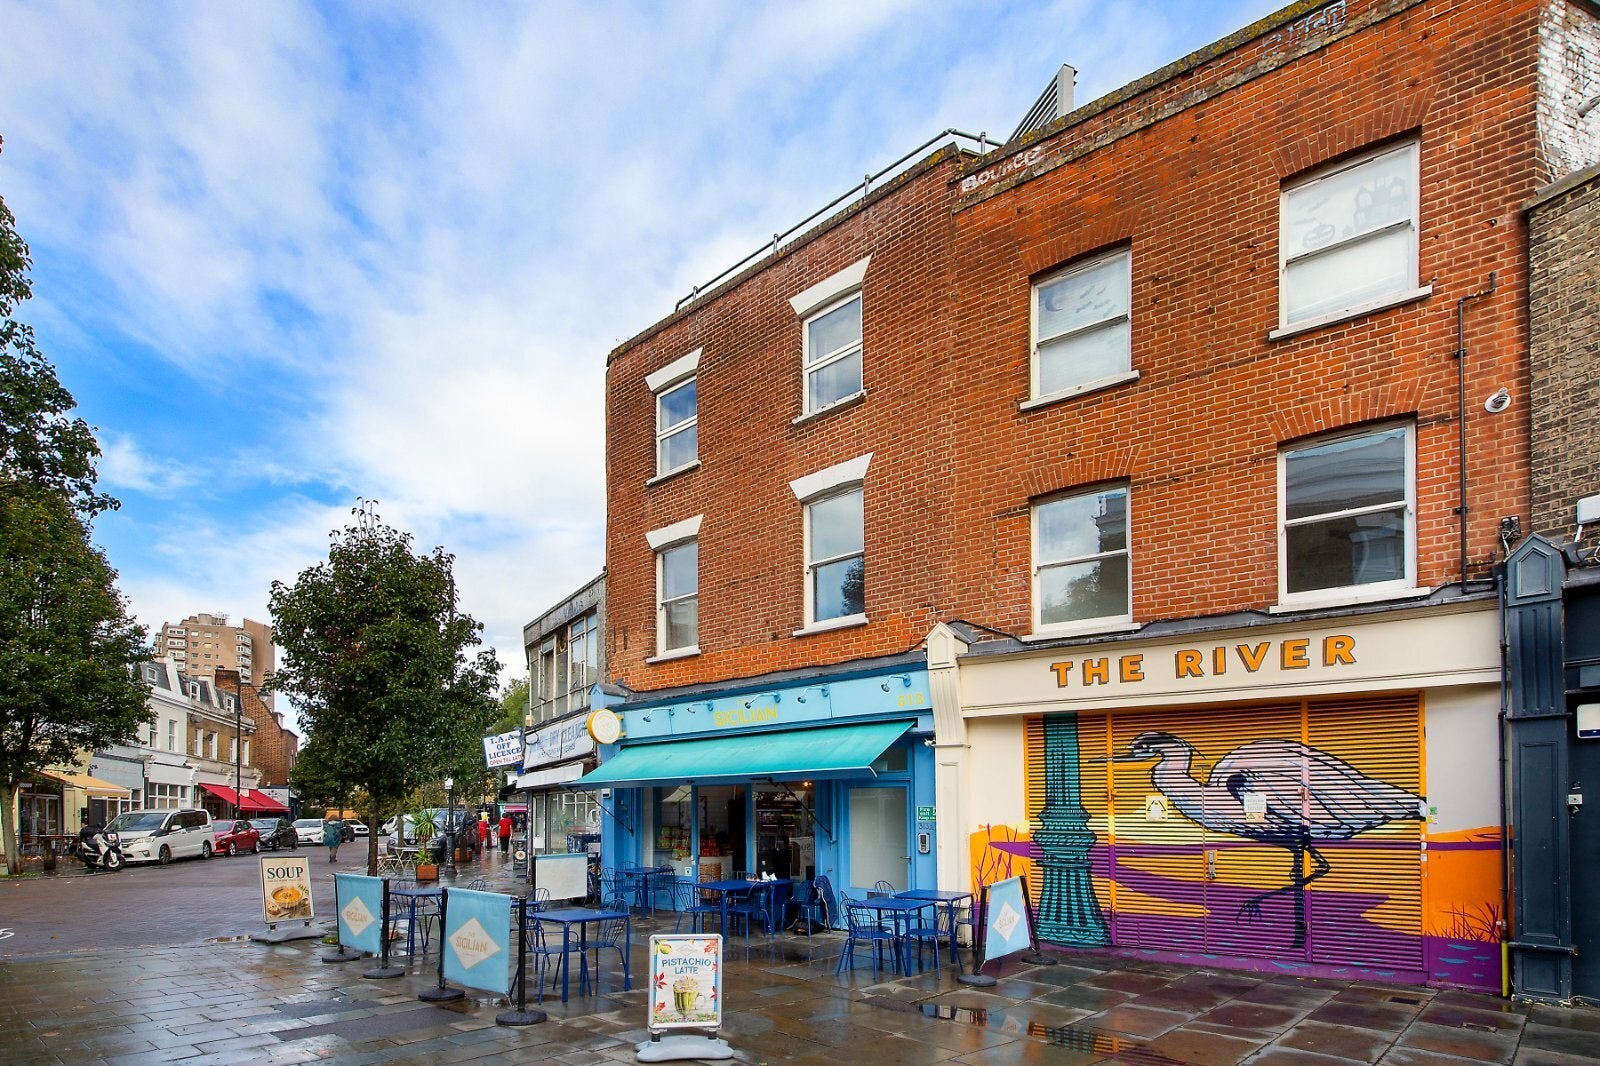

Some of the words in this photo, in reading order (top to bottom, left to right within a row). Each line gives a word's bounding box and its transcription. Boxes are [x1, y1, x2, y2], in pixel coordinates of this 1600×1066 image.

[1050, 653, 1145, 688] THE
[1175, 635, 1357, 679] RIVER
[896, 692, 924, 707] 313
[714, 705, 778, 727] SICILIAN
[488, 747, 522, 760] LICENCE
[496, 742, 511, 751] OFF
[266, 866, 304, 880] SOUP
[455, 936, 488, 953] SICILIAN
[661, 957, 712, 968] PISTACHIO
[674, 966, 699, 975] LATTE
